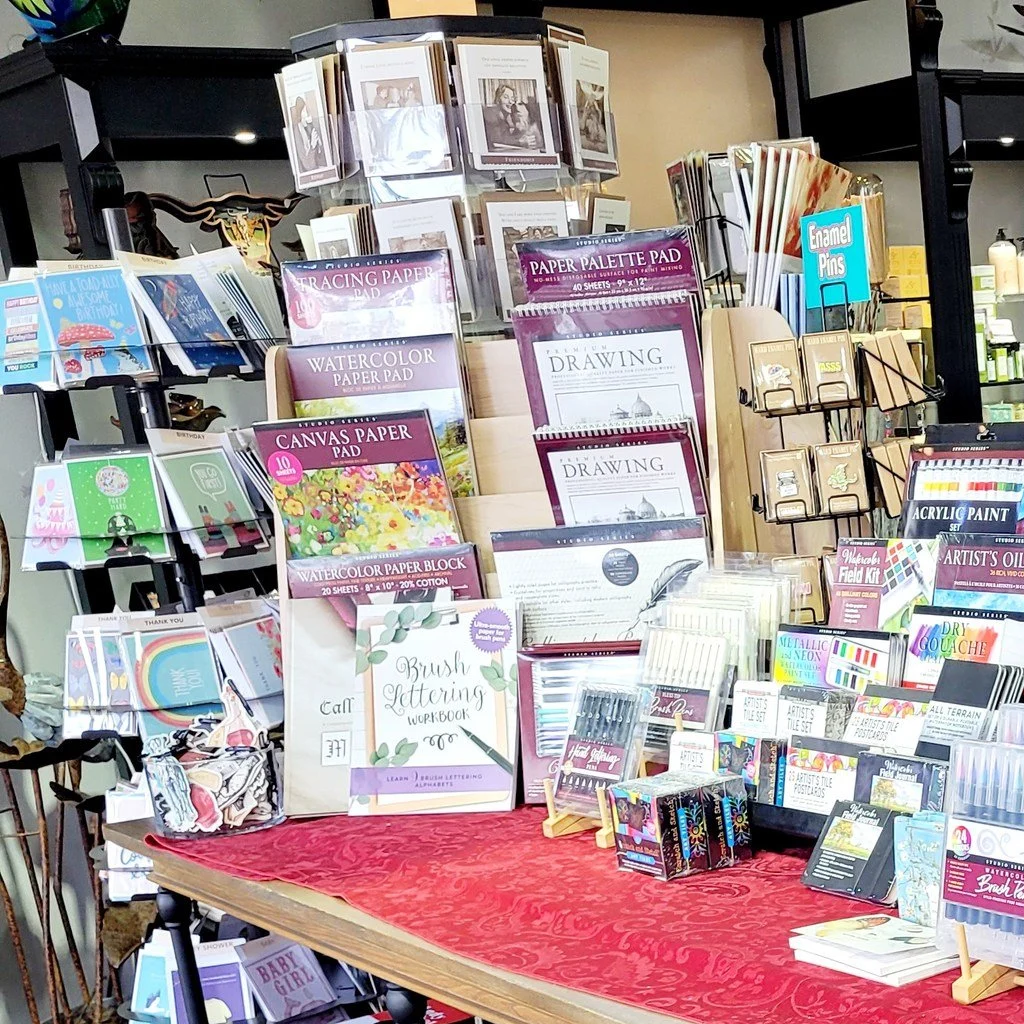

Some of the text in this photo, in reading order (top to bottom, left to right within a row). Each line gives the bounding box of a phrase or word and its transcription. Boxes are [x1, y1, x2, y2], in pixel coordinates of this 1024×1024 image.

[809, 217, 851, 248] Enamel
[529, 248, 681, 275] PAPER PALETTE PAD
[818, 254, 845, 276] Pins
[297, 266, 435, 291] TRACING PAPER
[572, 281, 610, 292] 40 SHEETS
[68, 291, 110, 307] AWESOME
[354, 288, 381, 300] PAD
[307, 348, 436, 373] WATERCOLOR
[550, 348, 662, 373] DRAWING
[333, 367, 414, 387] PAPER PAD
[176, 432, 205, 440] BIRTHDAY
[276, 425, 412, 450] CANVAS PAPER
[332, 445, 361, 459] PAD
[276, 456, 291, 470] 10
[563, 457, 665, 479] DRAWING
[912, 506, 1010, 522] ACRYLIC PAINT
[949, 523, 961, 532] SET
[942, 550, 998, 568] ARTIST'S
[297, 557, 467, 583] WATERCOLOR PAPER BLOCK
[838, 568, 881, 584] Field Kit
[333, 578, 449, 594] SHEETS COTTON
[941, 621, 968, 637] DRY
[779, 637, 829, 651] METALLIC
[919, 636, 987, 657] GOUACHE
[793, 651, 822, 662] NEON
[395, 650, 471, 683] Brush
[382, 681, 487, 717] Lettering
[407, 709, 471, 726] WORKBOOK
[787, 707, 815, 720] ARTIST'S
[929, 706, 982, 720] ALL TERRAIN
[788, 721, 813, 734] TILE SET
[793, 786, 826, 798] POSTCARDS
[974, 874, 1011, 898] Brush
[256, 952, 299, 984] BABY
[273, 966, 314, 996] GIRL
